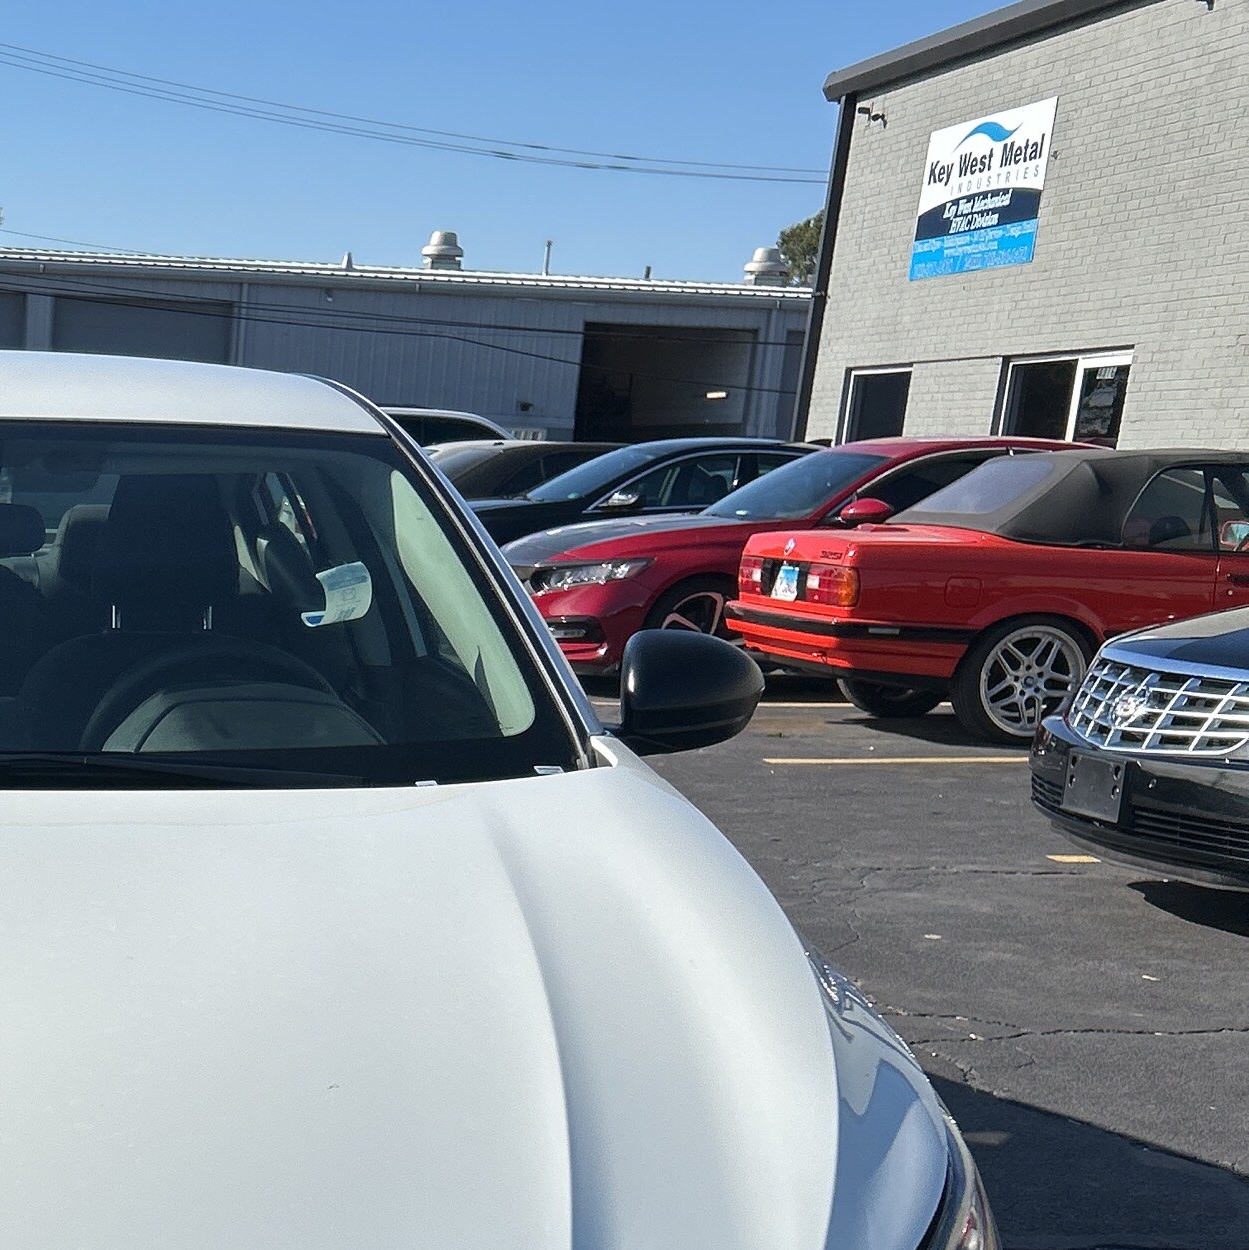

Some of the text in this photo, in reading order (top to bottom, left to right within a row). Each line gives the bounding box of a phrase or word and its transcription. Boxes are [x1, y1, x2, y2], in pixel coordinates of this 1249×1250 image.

[928, 133, 1046, 186] Key West Metal
[950, 164, 1039, 196] INDUSTRIES
